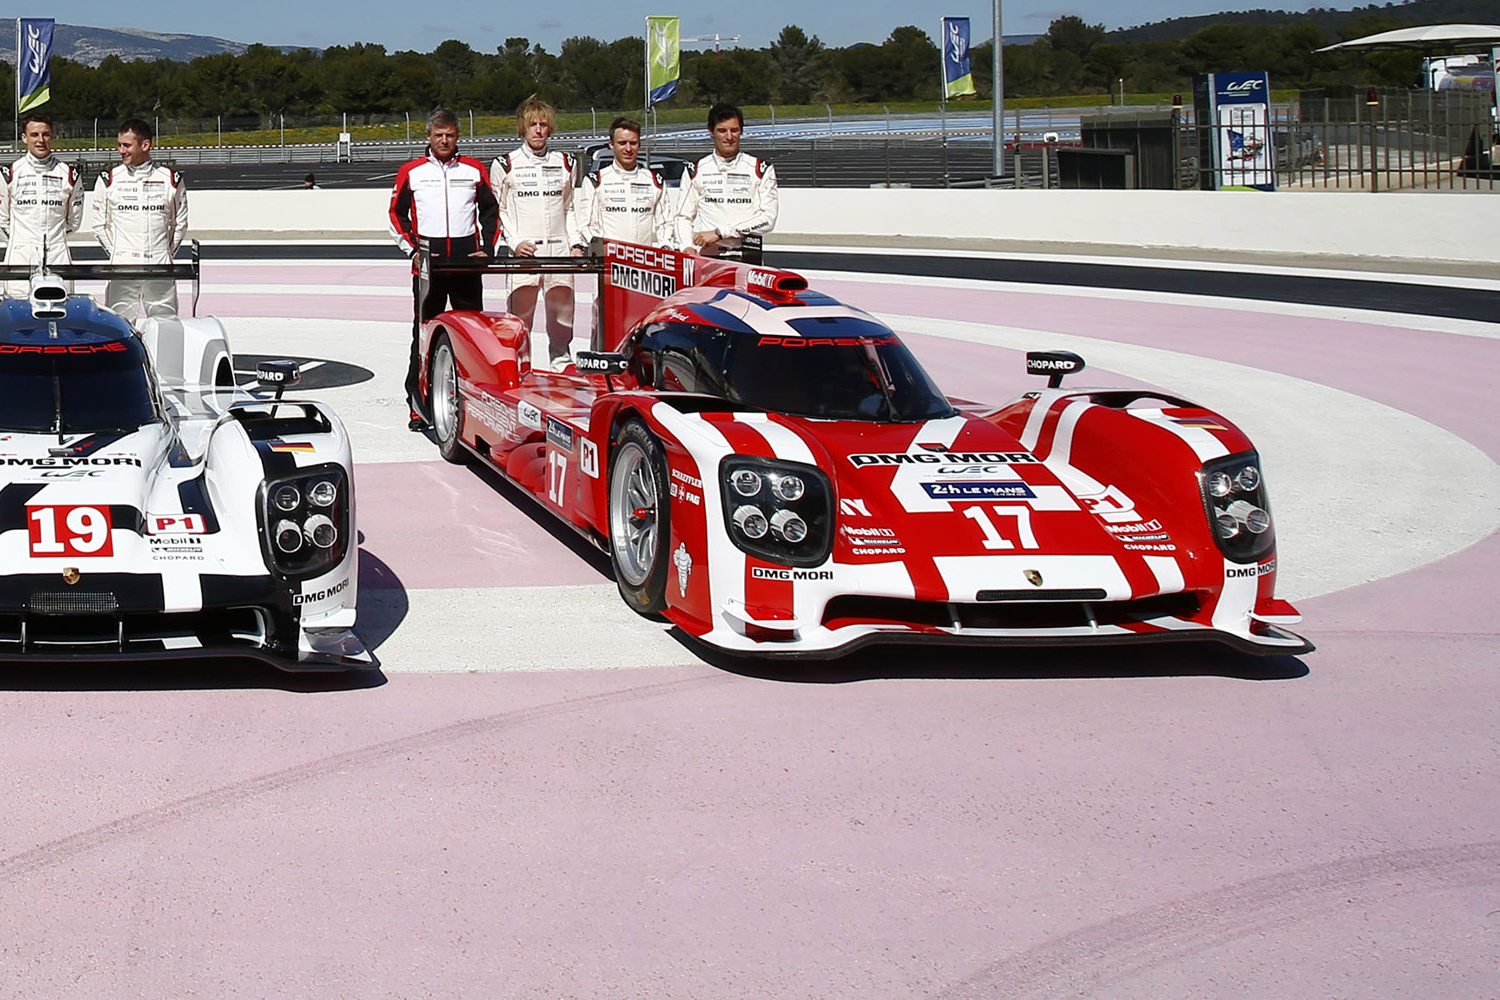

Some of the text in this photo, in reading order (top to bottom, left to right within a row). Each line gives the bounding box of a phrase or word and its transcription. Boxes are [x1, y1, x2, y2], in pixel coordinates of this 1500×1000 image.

[28, 24, 39, 74] WEC
[949, 22, 959, 63] WEC
[1227, 80, 1263, 90] WEC
[607, 243, 695, 286] PORSCHE HY
[612, 264, 676, 300] DMG MORI
[748, 270, 767, 287] Mobil
[1027, 359, 1076, 370] CHOPARD
[62, 457, 142, 468] MORI
[583, 442, 595, 473] P1
[850, 453, 941, 466] DMG
[937, 466, 998, 474] WEC
[549, 450, 567, 508] 17
[686, 491, 700, 505] FAG
[1081, 494, 1124, 510] P1
[31, 506, 108, 553] 19
[156, 517, 193, 531] P1
[842, 524, 881, 536] Mobil
[962, 505, 1040, 550] 17
[1104, 522, 1148, 533] Mobil
[149, 537, 187, 545] Mobil
[1124, 543, 1177, 551] CHOPARD
[852, 547, 906, 555] CHOPARD
[753, 568, 834, 580] DMG MORI
[1226, 567, 1256, 578] DMG
[294, 576, 350, 605] DMG MORI
